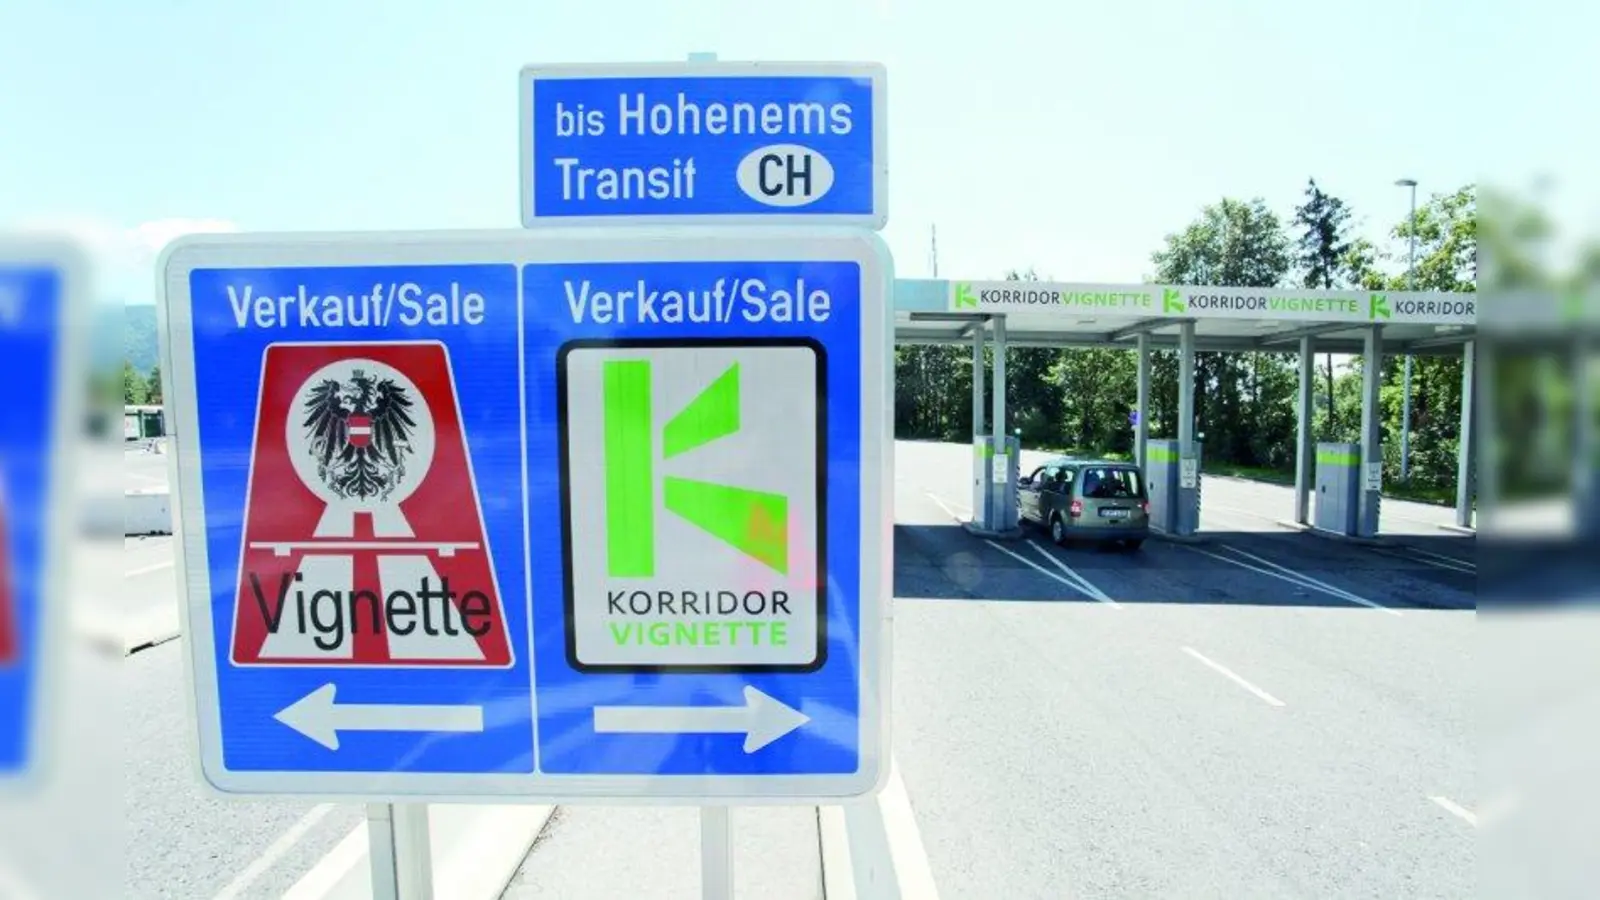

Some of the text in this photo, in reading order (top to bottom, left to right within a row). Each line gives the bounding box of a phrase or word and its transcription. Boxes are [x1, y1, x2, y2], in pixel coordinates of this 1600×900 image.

[555, 92, 853, 136] bis Hohenems
[554, 153, 813, 200] Transit CH
[227, 281, 486, 329] Verkauf/Sale
[564, 278, 832, 324] Verkauf/Sale
[1395, 300, 1475, 316] KORRIDOR
[250, 571, 492, 652] Vignette
[607, 590, 792, 615] KORRIDOR
[609, 621, 788, 647] VIGNETTE
